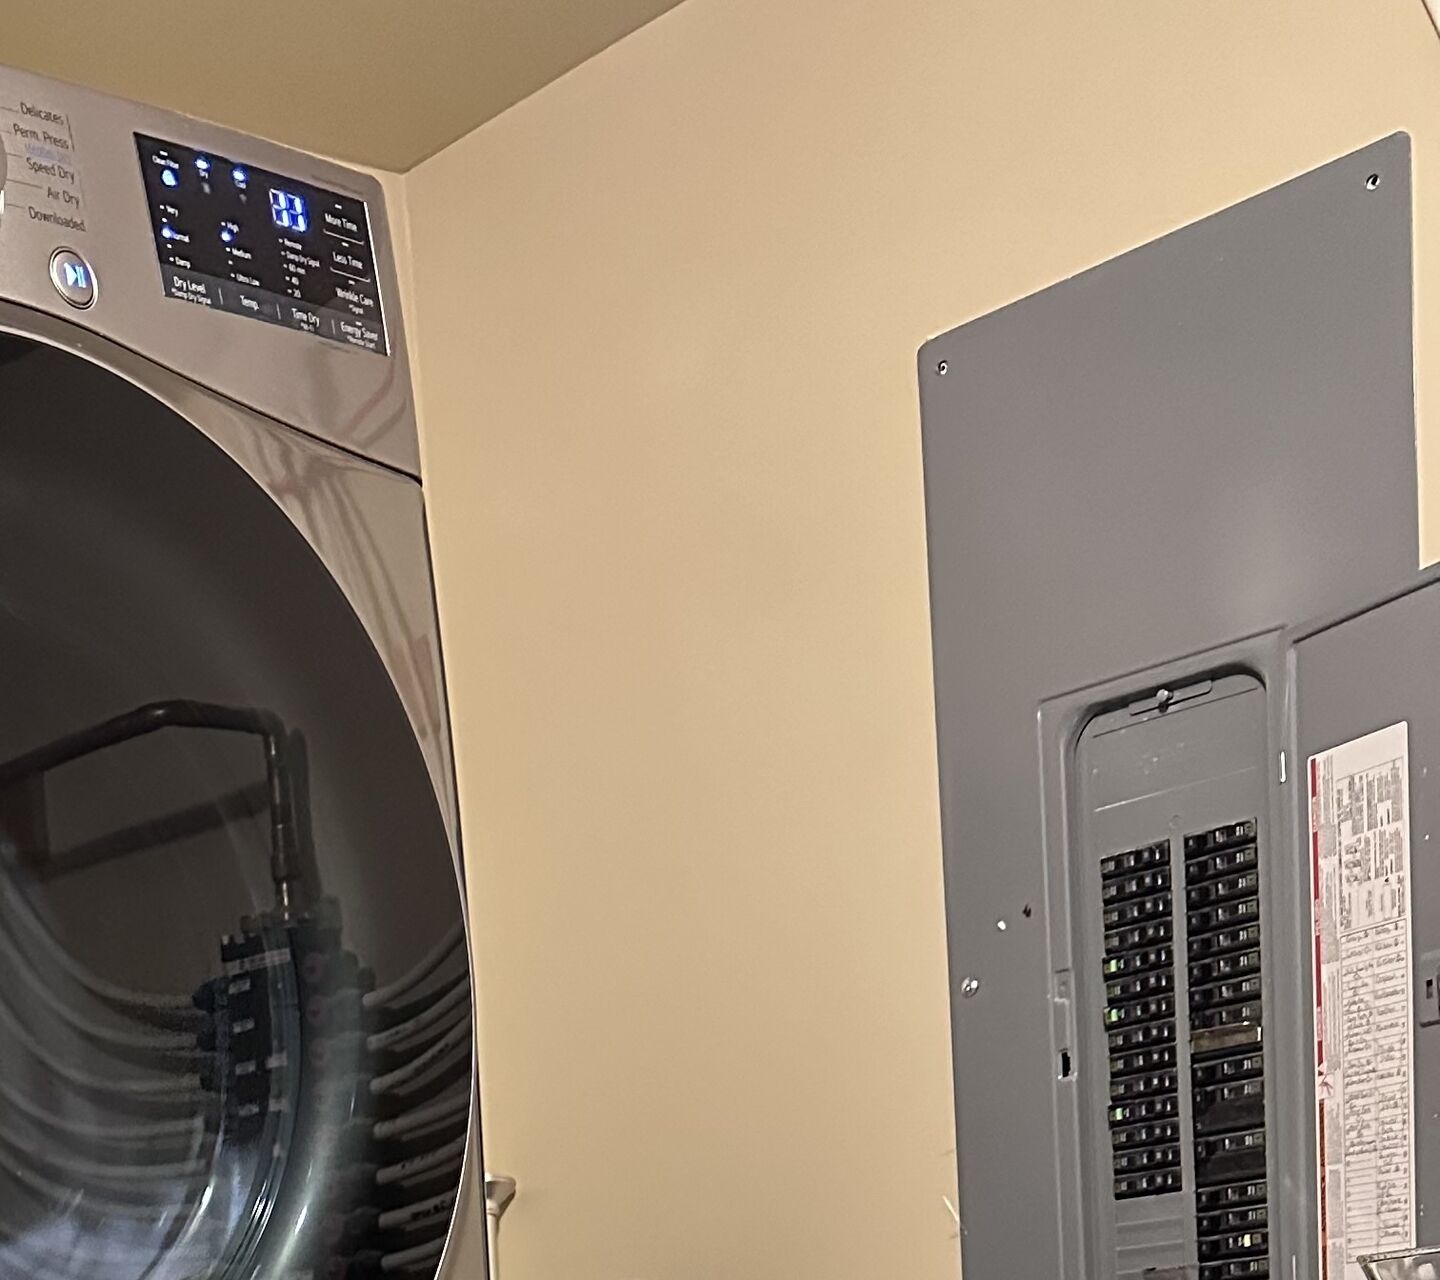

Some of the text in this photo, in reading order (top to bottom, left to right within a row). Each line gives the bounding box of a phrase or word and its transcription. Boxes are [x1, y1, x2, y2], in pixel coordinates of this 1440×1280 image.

[20, 101, 64, 125] Delicates
[43, 131, 69, 150] Press
[26, 157, 75, 184] Speed Dry
[62, 190, 80, 209] Dry
[28, 206, 87, 232] Downloaded
[341, 218, 358, 232] Time
[348, 256, 363, 269] Time
[173, 276, 187, 291] Dry
